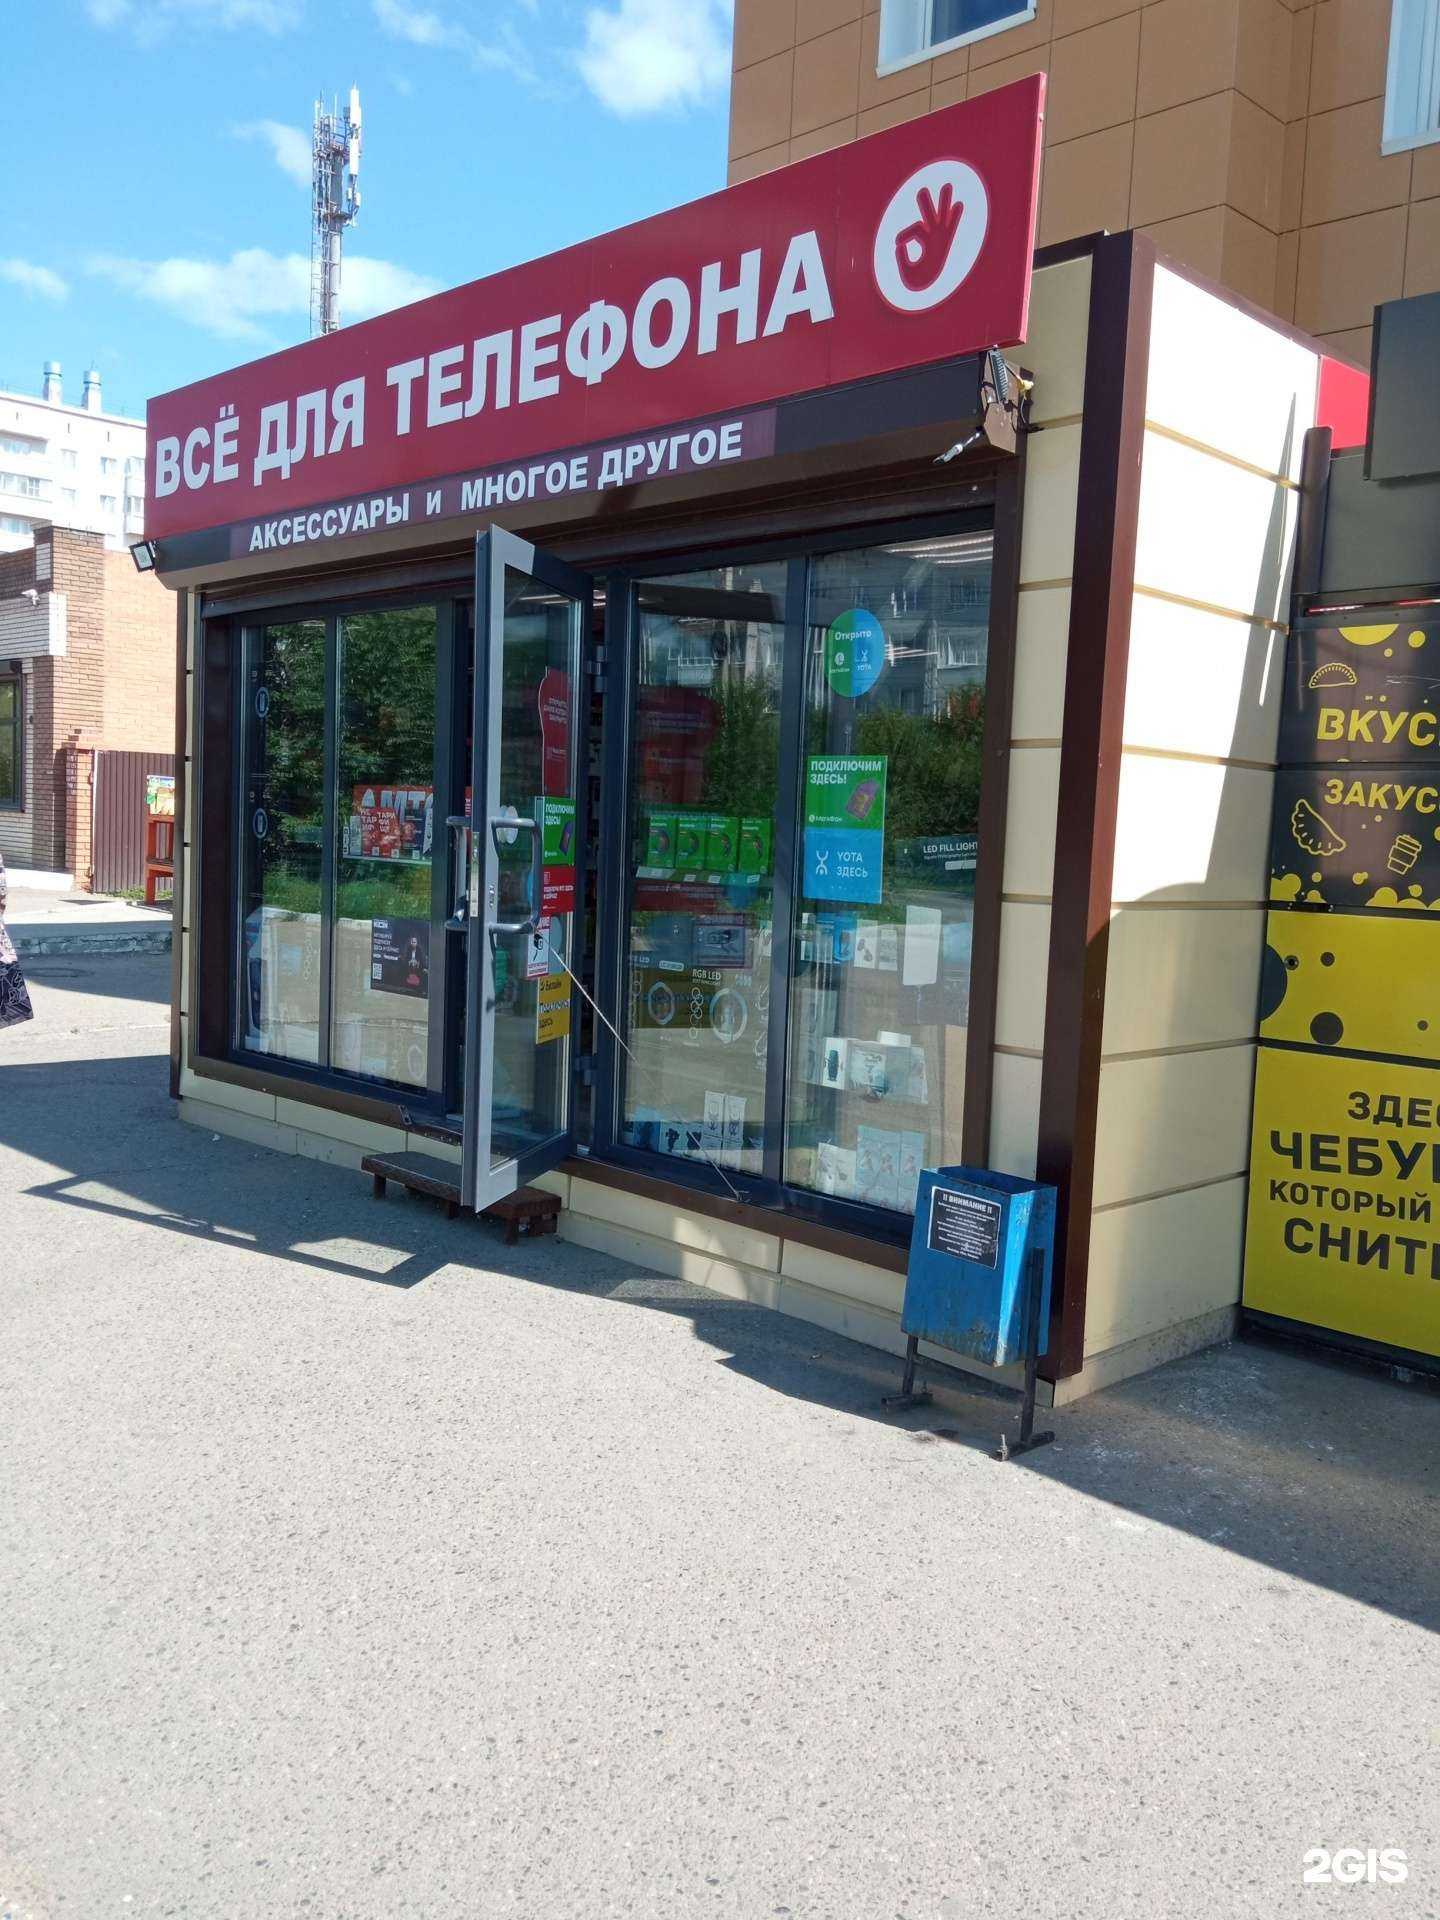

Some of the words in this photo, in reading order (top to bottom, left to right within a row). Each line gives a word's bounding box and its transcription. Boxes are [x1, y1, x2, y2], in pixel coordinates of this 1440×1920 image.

[155, 403, 240, 498] ВСЁ
[253, 376, 366, 487] ДЛЯ
[386, 230, 834, 435] ТЕЛЕФОНА
[249, 493, 410, 551] АКСЕССУАРЫ
[460, 456, 589, 510] МНОГОЕ
[597, 422, 743, 489] ДРУГОЕ
[835, 630, 872, 641] Открыто
[1317, 707, 1440, 747] ВКУС
[810, 773, 847, 785] ЗДЕСЬ!
[811, 760, 882, 772] ПОДКЛЮЧИМ
[1324, 778, 1440, 814] ЗАКУС
[836, 851, 863, 862] YOTA
[923, 844, 938, 854] LED
[939, 843, 954, 853] FILL
[836, 867, 869, 878] ЗДЕСЬ
[1347, 1091, 1440, 1128] ЗДЕ
[1270, 1130, 1440, 1183] ЧЕБУ
[1269, 1179, 1432, 1223] КОТОРЫЙ
[1284, 1217, 1440, 1280] СНИТ
